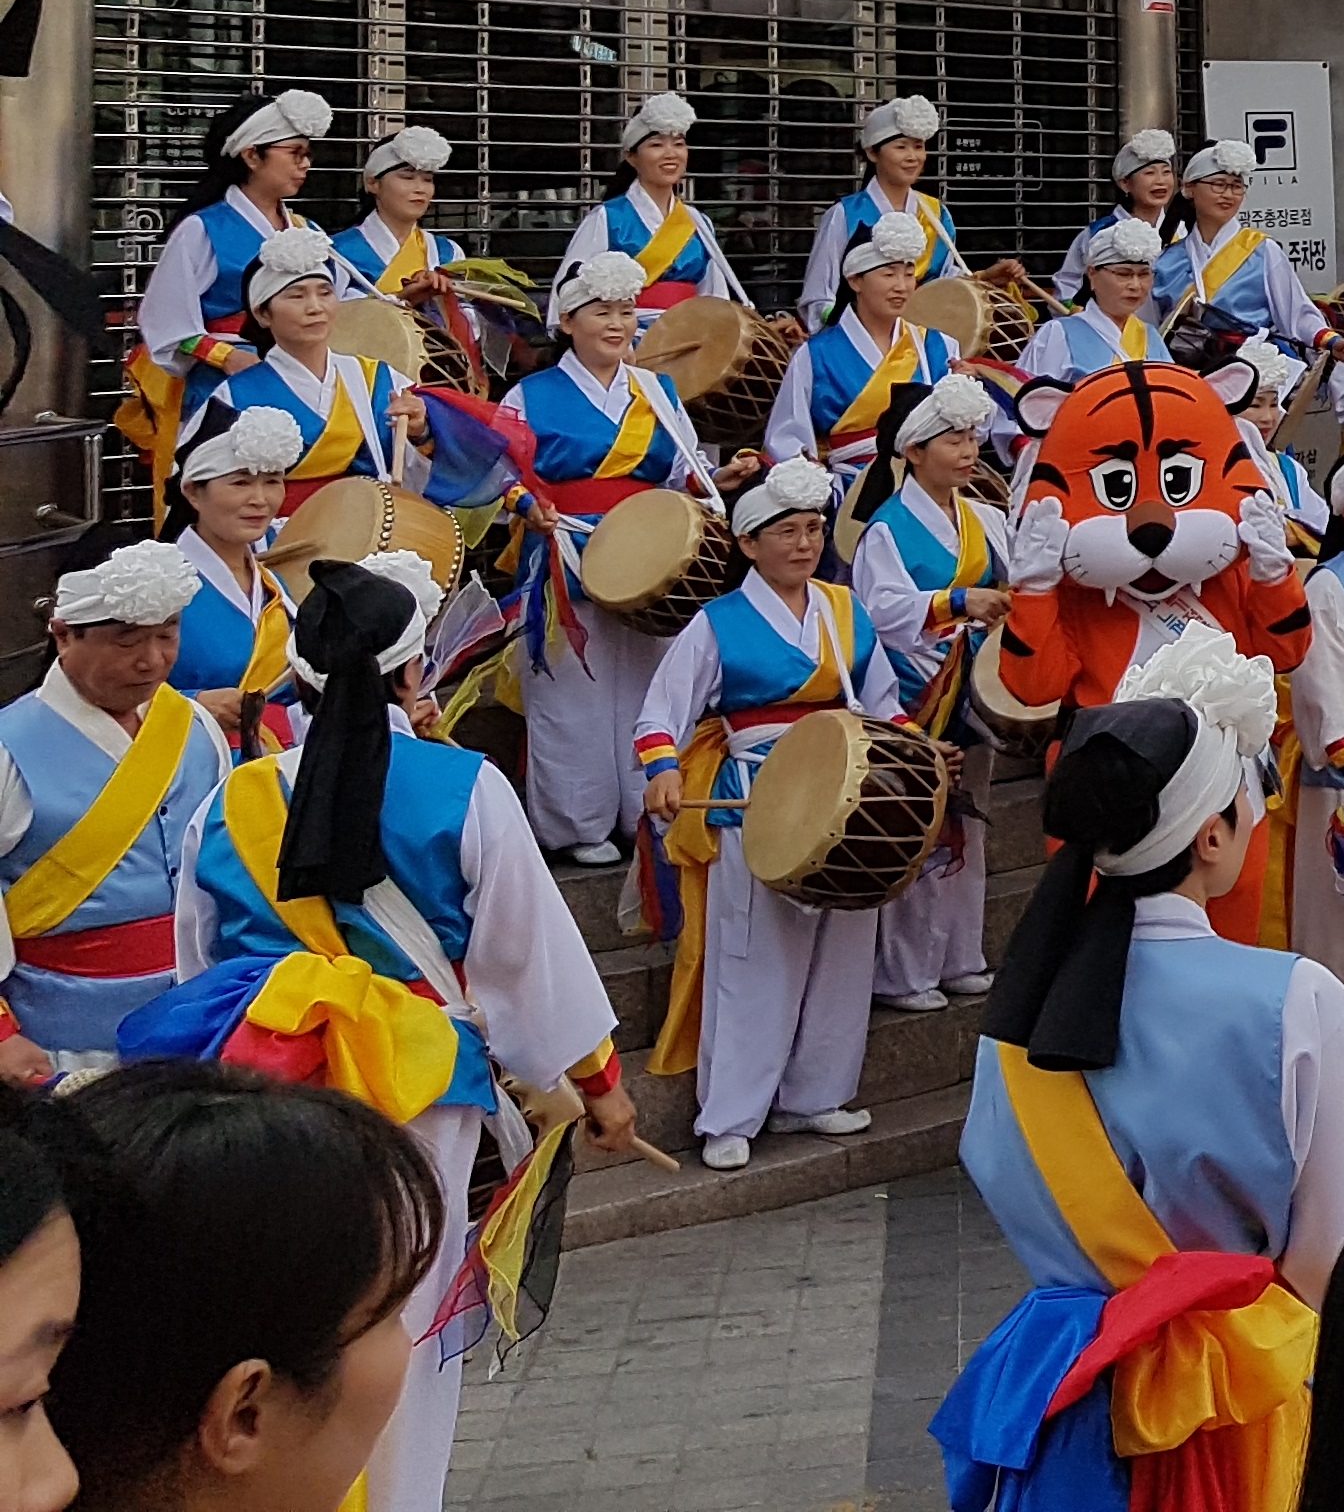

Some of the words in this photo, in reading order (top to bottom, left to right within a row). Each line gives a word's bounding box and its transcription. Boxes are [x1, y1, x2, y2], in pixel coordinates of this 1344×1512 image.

[1249, 176, 1299, 186] FILA
[1238, 208, 1313, 229] 광주충장로점
[1288, 239, 1327, 272] 주차장
